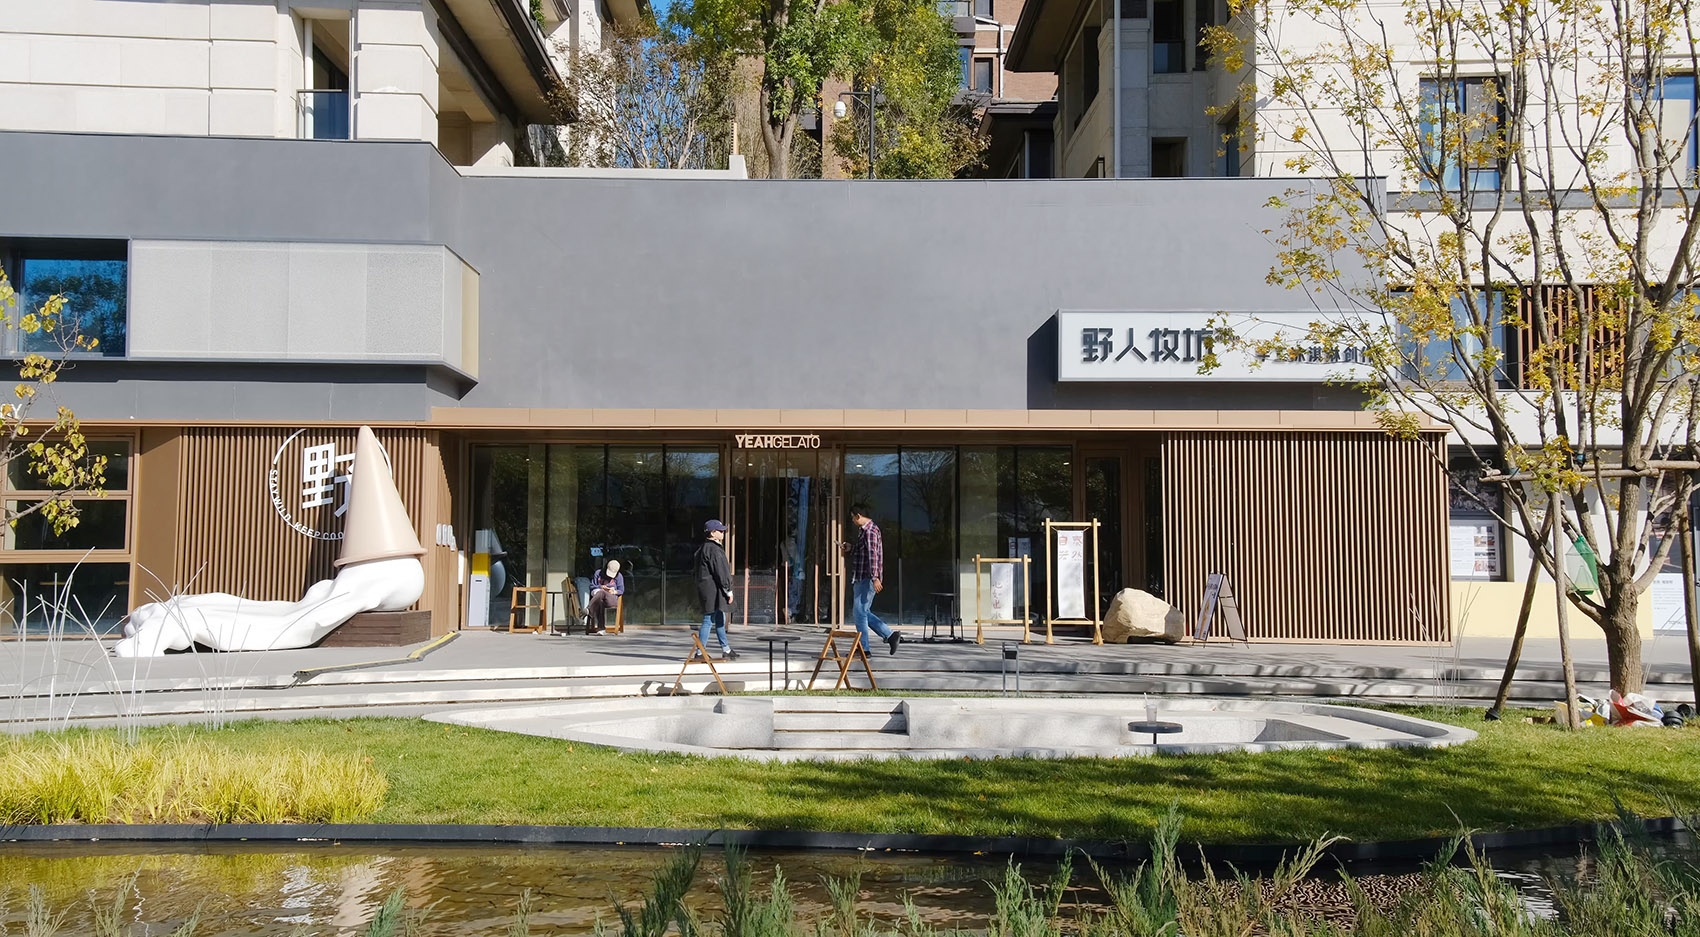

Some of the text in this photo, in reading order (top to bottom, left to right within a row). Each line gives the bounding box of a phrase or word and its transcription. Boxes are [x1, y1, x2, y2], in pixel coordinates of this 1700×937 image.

[1082, 328, 1213, 362] 野人牧坊
[293, 521, 321, 537] KEEP
